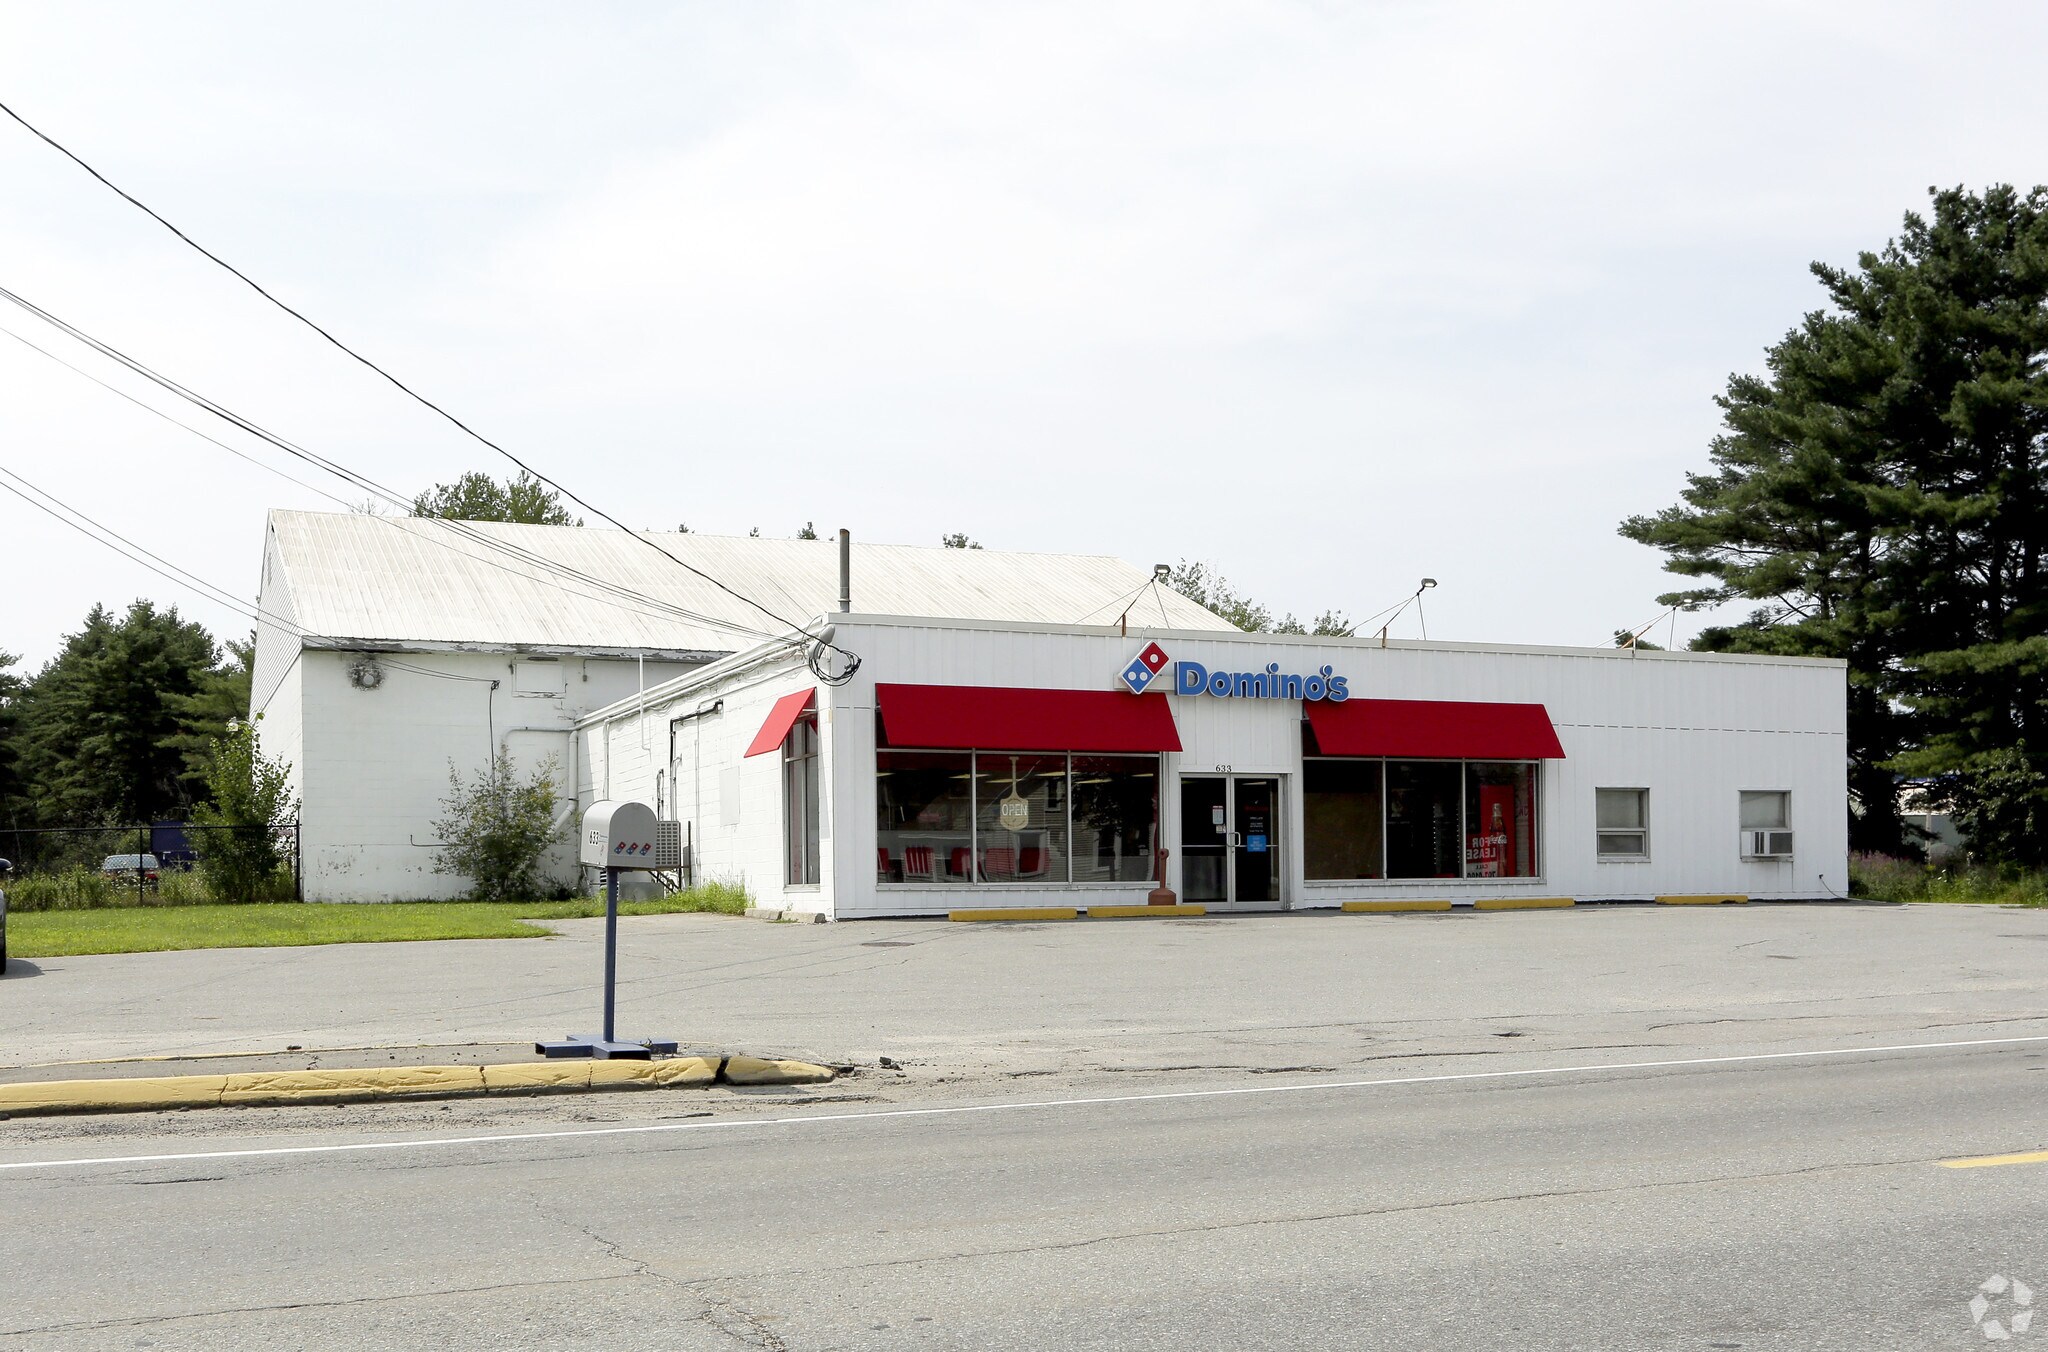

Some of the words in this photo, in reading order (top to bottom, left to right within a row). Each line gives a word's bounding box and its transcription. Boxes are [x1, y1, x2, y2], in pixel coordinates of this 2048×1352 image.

[1174, 661, 1350, 701] Domino's
[1215, 764, 1232, 773] 633
[1001, 803, 1028, 816] OPEN
[589, 830, 600, 845] 633
